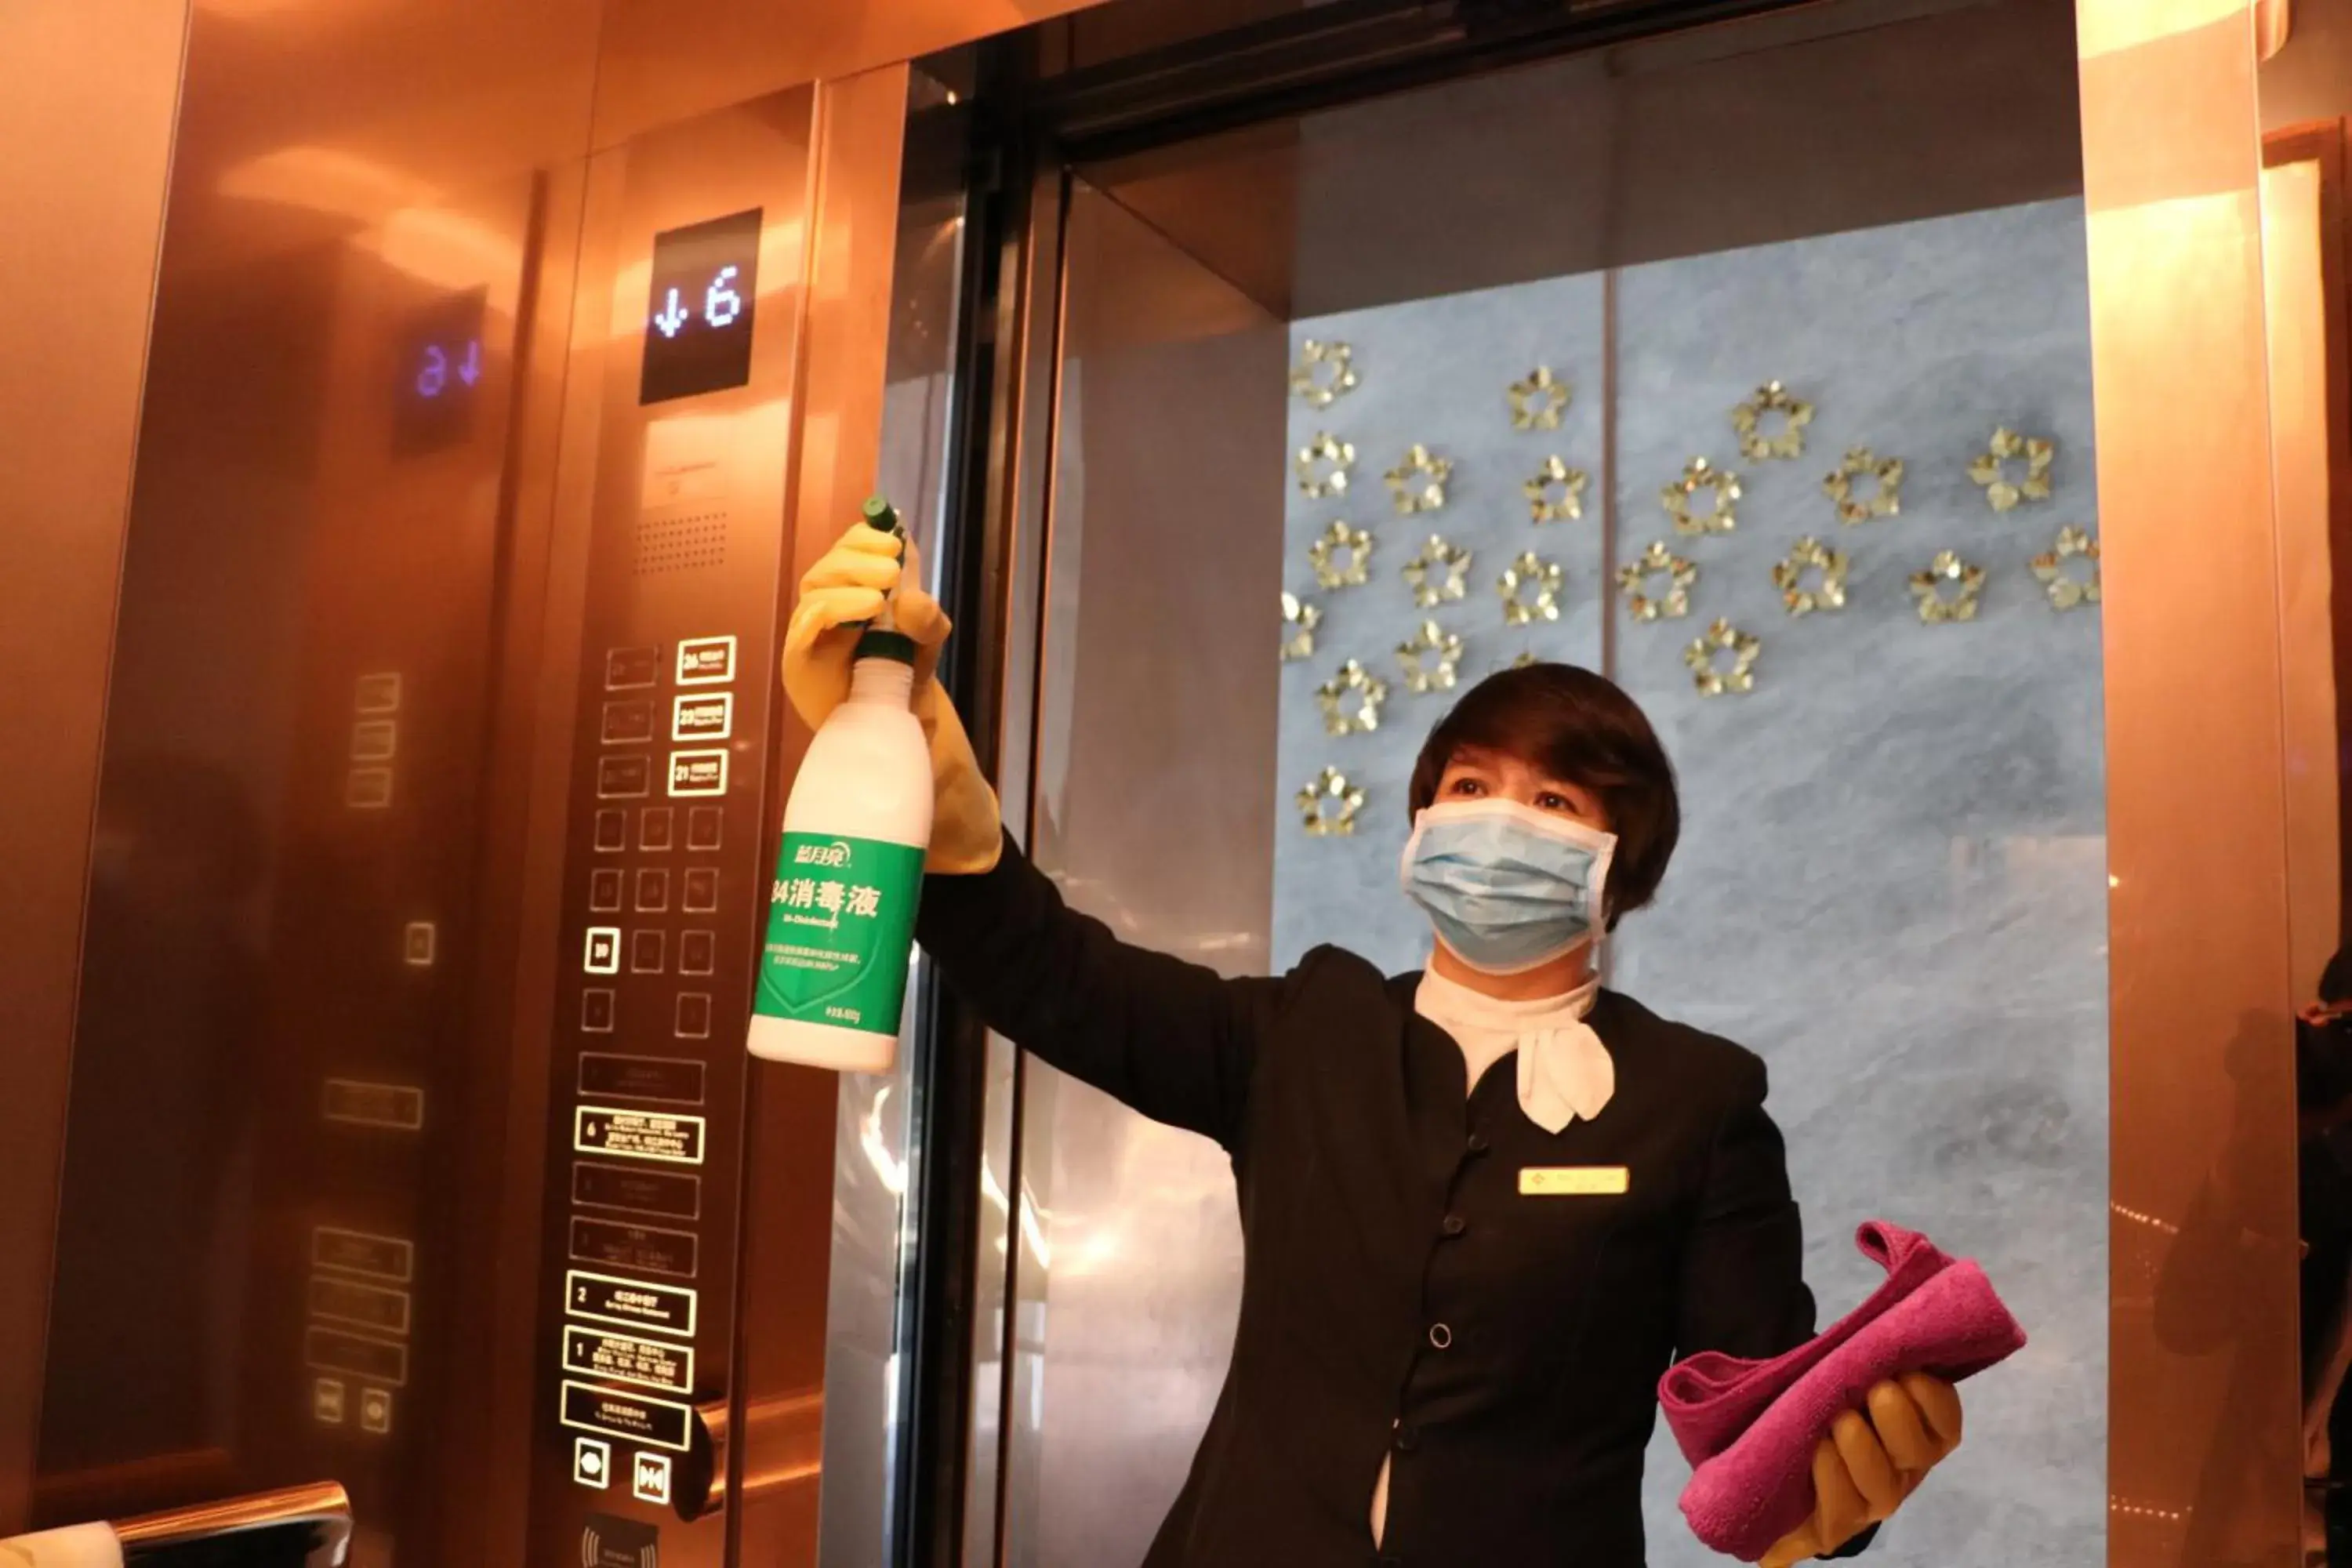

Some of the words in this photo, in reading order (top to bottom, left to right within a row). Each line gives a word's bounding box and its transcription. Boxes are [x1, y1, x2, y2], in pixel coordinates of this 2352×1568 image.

[705, 265, 741, 328] 6
[586, 1120, 597, 1138] 6
[577, 1286, 587, 1303] 2
[576, 1341, 584, 1357] 1
